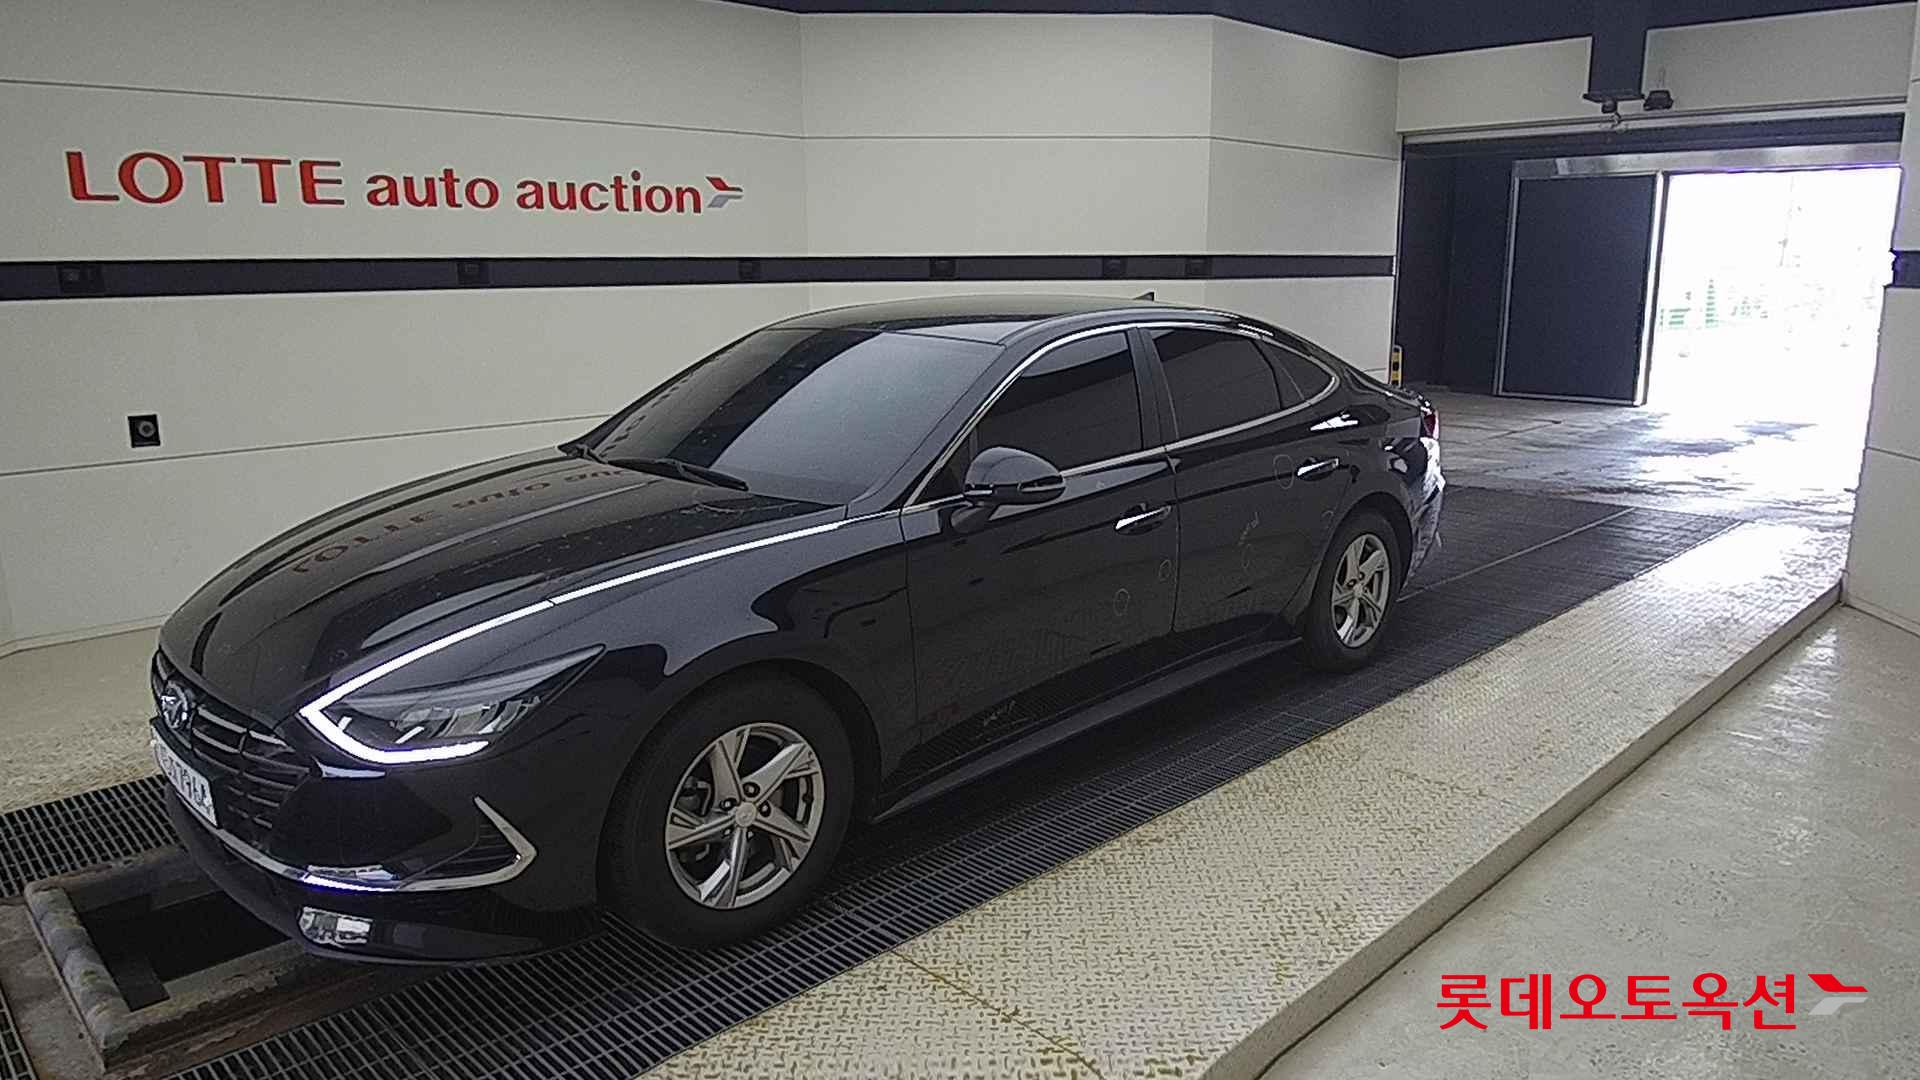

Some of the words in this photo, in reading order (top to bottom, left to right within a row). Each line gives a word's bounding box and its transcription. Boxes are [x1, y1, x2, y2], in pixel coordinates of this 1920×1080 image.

[66, 151, 346, 205] LOTTE
[366, 168, 499, 210] auto
[517, 171, 703, 214] auction
